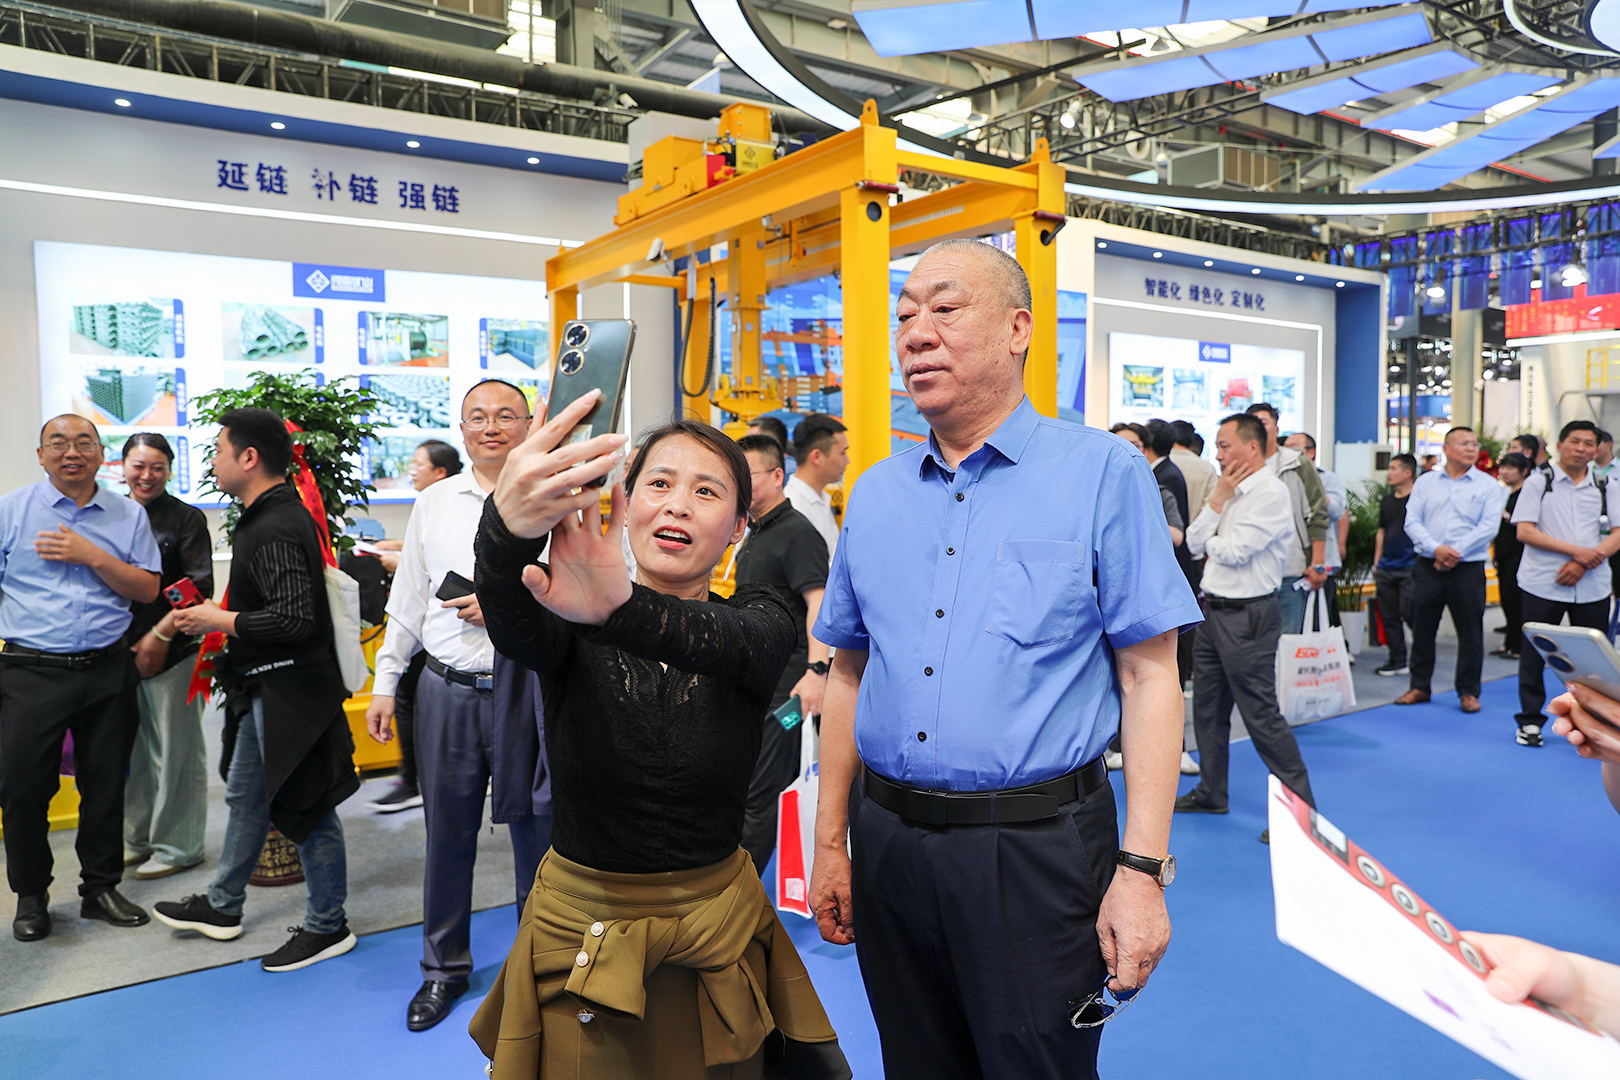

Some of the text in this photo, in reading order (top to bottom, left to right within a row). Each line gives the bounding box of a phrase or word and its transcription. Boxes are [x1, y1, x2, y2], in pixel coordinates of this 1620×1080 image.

[217, 159, 460, 213] 延链 补链 强链
[1145, 277, 1265, 311] 智能化 绿色化 定制化
